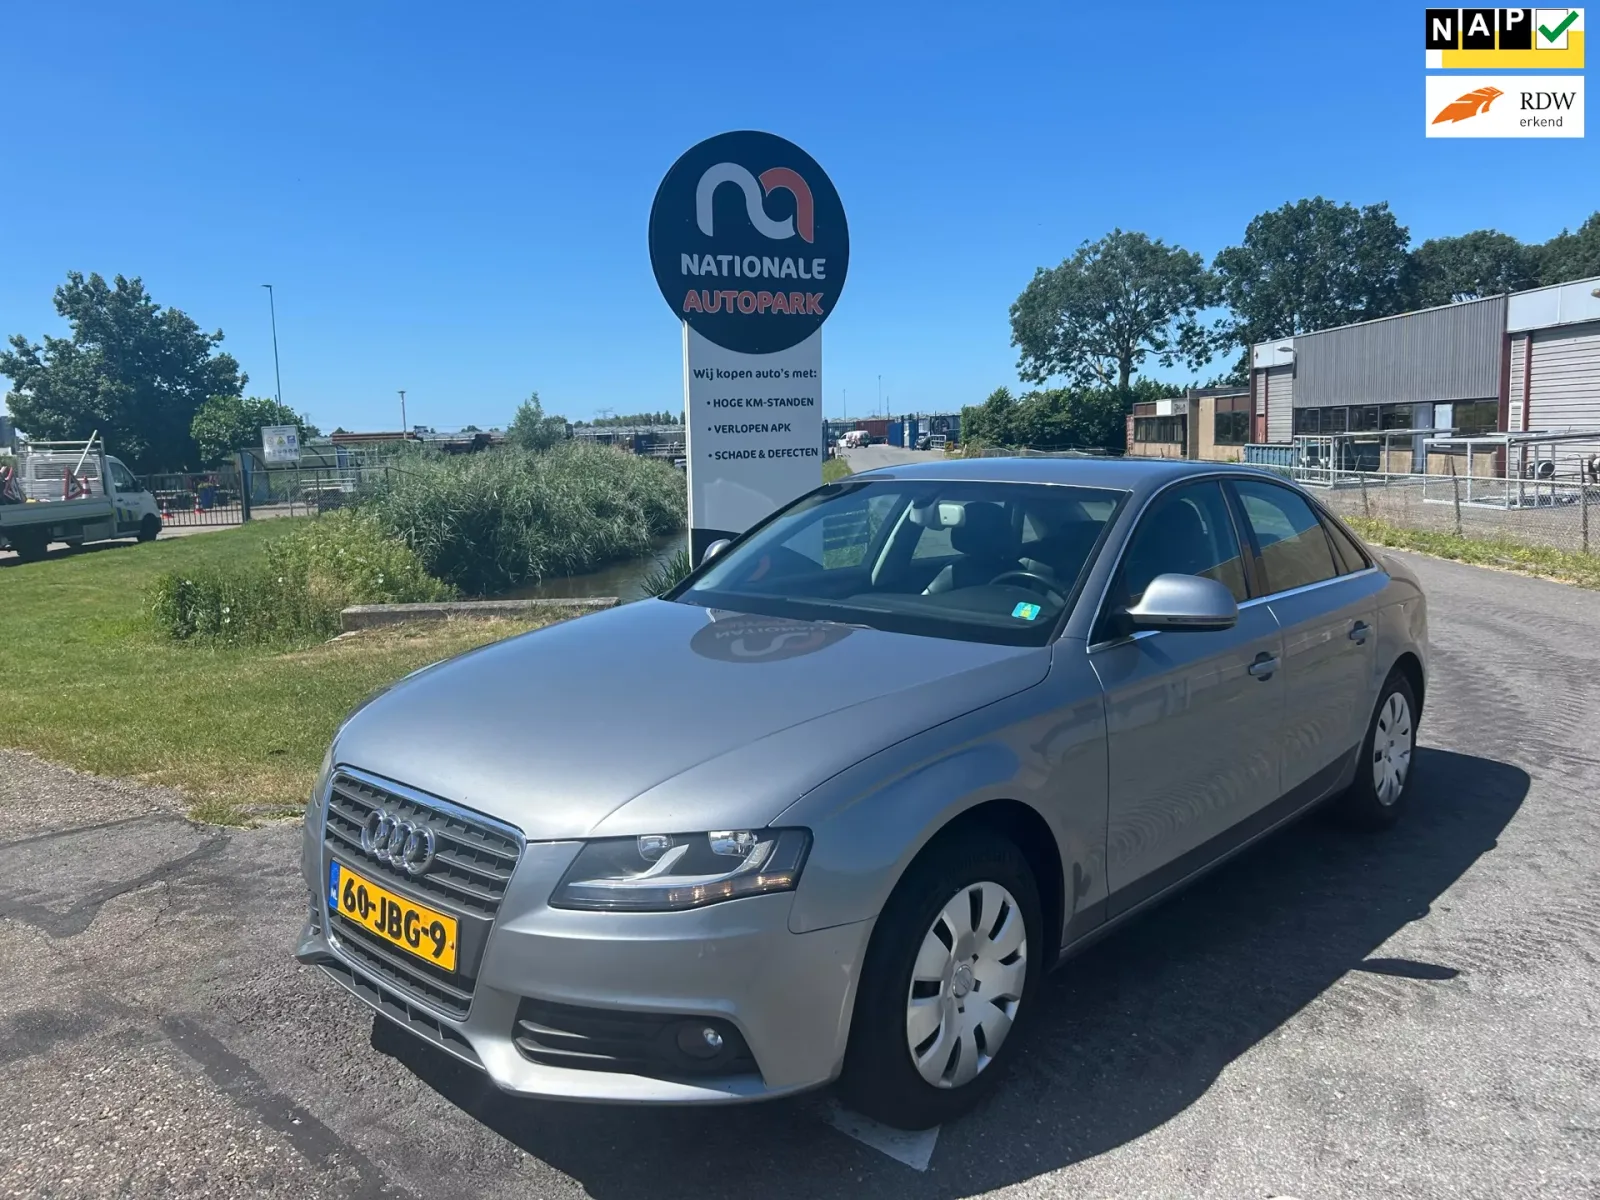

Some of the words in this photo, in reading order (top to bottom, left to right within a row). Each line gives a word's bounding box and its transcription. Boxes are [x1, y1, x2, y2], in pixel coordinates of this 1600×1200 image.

[681, 253, 826, 280] NATIONALE
[683, 289, 824, 315] AUTOPARK
[693, 368, 714, 380] Wij
[716, 368, 753, 380] kopen
[755, 368, 790, 378] auto's
[792, 369, 817, 378] met:
[713, 398, 743, 408] HOGE
[745, 397, 814, 407] KM-STANDEN
[714, 423, 769, 434] VERLOPEN
[770, 423, 792, 433] APK
[715, 449, 757, 460] SCHADE
[758, 449, 766, 459] &
[768, 447, 818, 459] DEFECTEN
[343, 877, 447, 959] 60-JBG-9
